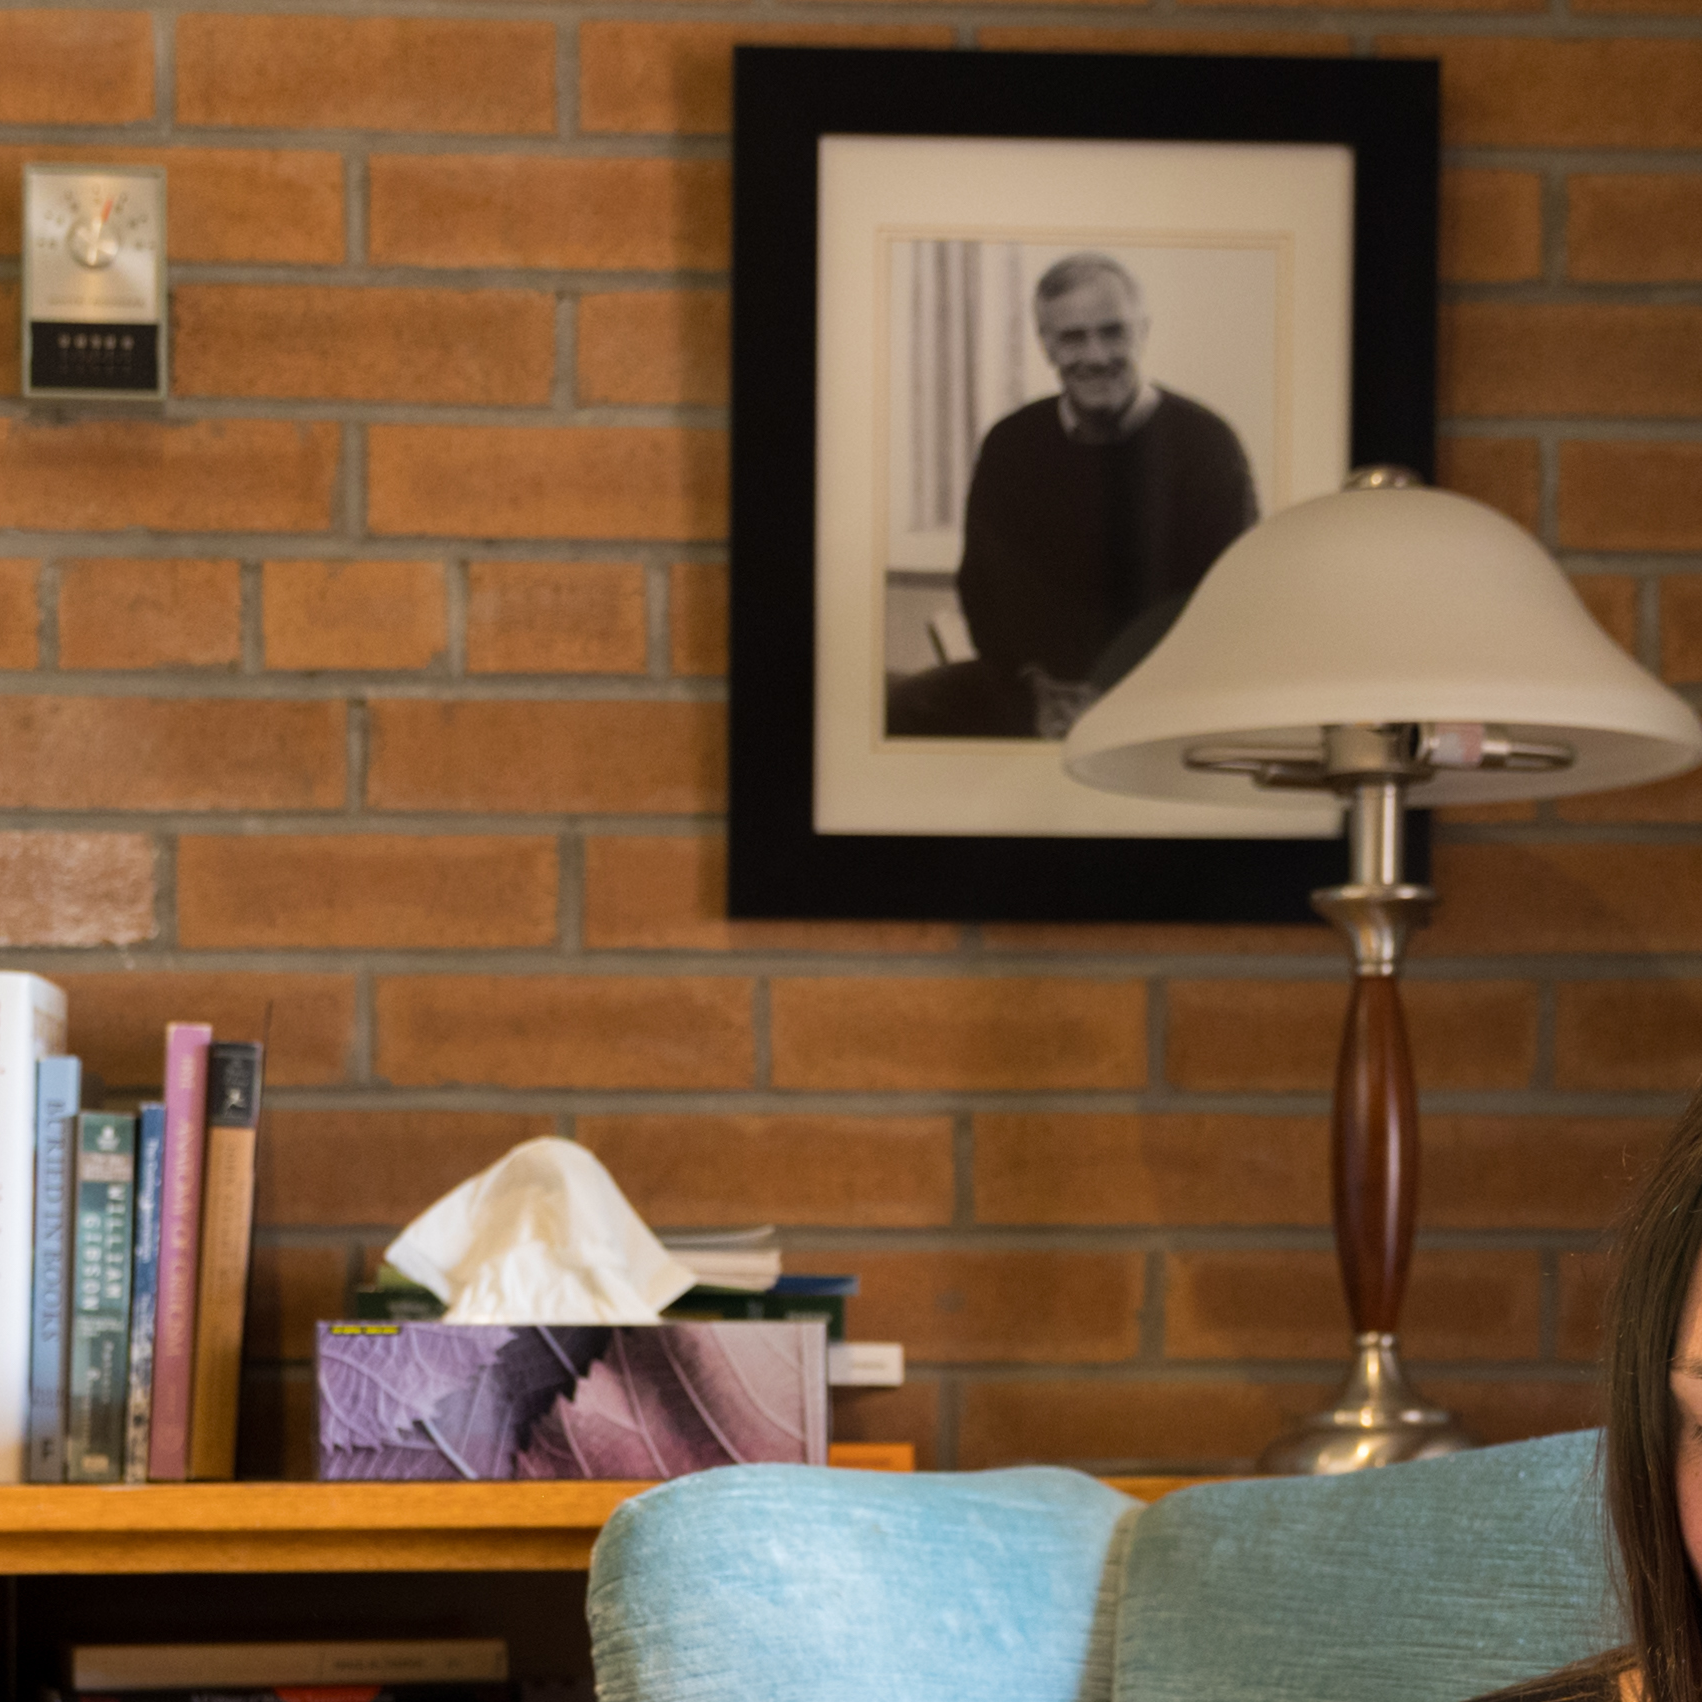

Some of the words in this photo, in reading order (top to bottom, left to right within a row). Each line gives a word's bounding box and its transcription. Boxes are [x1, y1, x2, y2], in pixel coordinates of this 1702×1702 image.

[43, 1099, 65, 1204] BURIED
[42, 1211, 63, 1242] IN
[83, 1212, 102, 1312] GIBSON
[105, 1184, 125, 1298] WILLIAM
[40, 1251, 62, 1343] BOOKS
